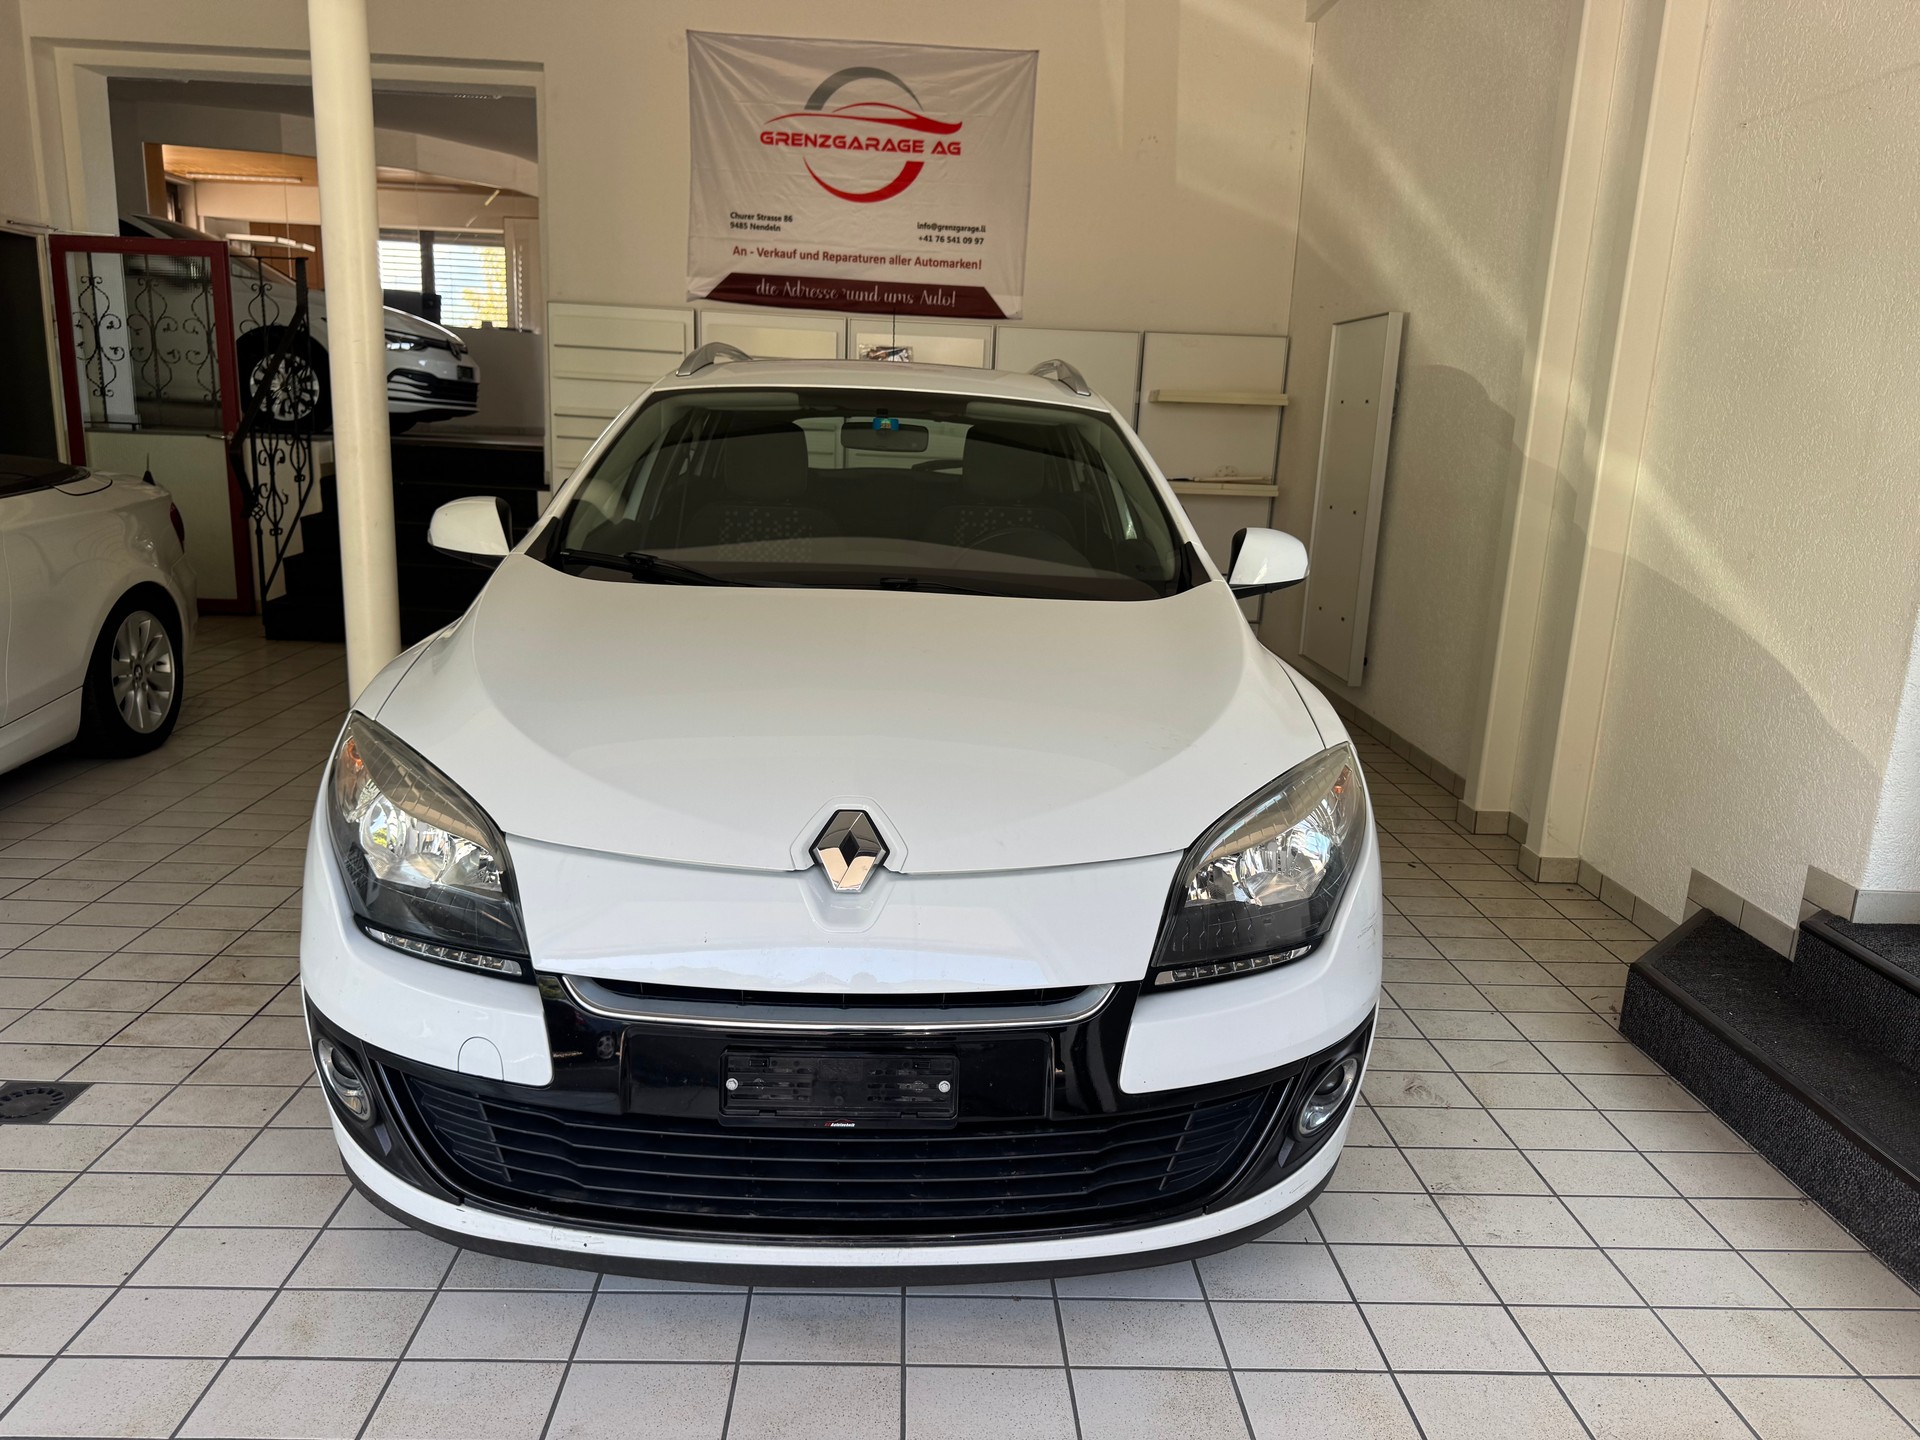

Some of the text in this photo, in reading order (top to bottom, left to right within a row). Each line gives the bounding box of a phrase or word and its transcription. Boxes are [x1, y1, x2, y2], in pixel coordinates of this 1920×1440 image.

[760, 131, 961, 156] GRENZGARAGE AG
[730, 212, 793, 223] Churer Strasse 86
[730, 221, 781, 232] 9485 Nendeln
[917, 221, 986, 234] info@grenzgarage.li
[918, 234, 984, 245] +41 76 541 09 97
[733, 246, 747, 256] An
[757, 247, 797, 259] Verkauf
[800, 250, 820, 261] und
[822, 252, 886, 264] Reparaturen
[889, 255, 912, 266] aller
[914, 256, 982, 270] Automarken!
[756, 278, 956, 308] die Adresse rund ums Auto!
